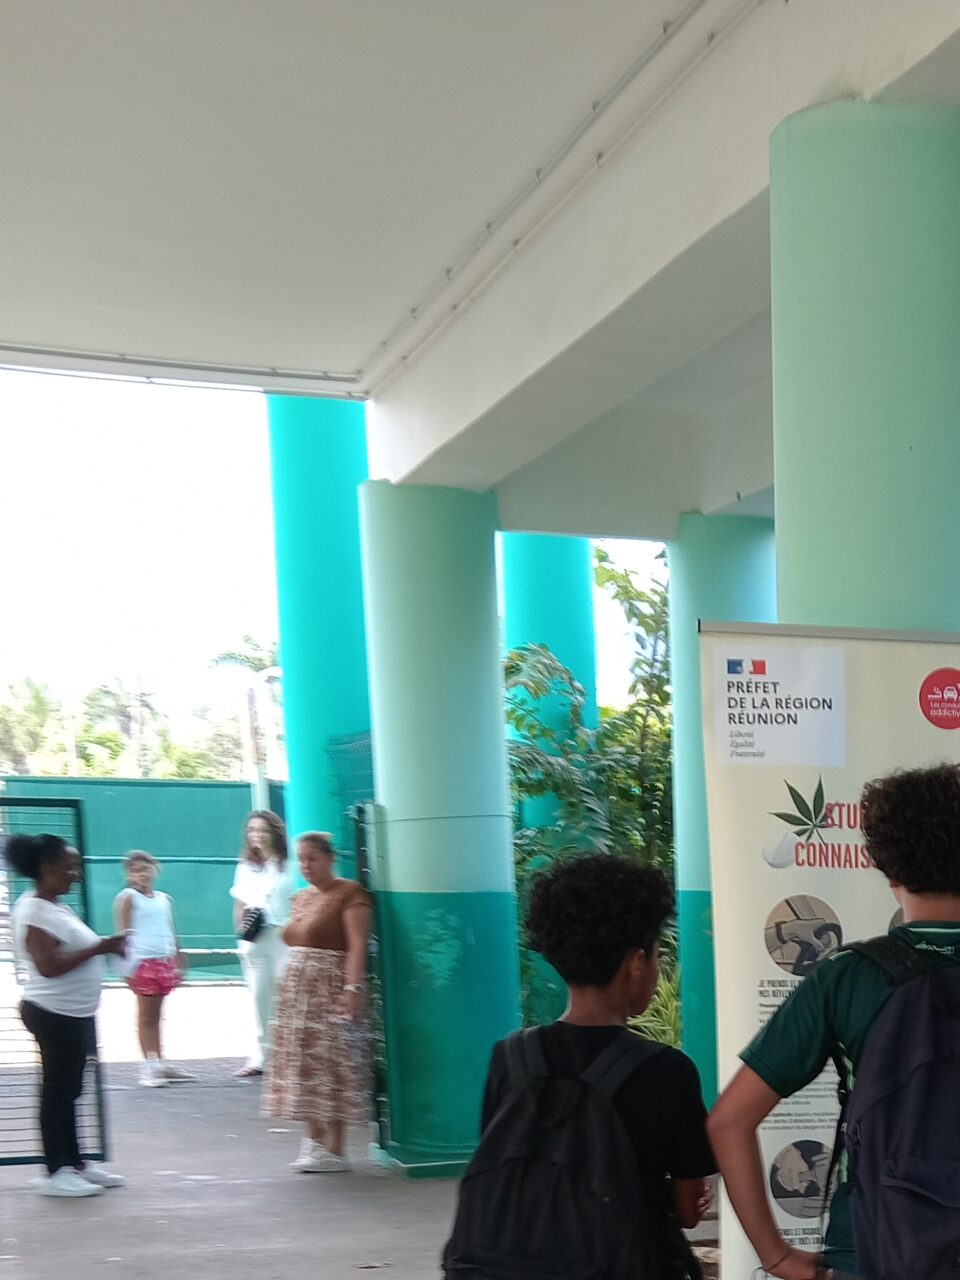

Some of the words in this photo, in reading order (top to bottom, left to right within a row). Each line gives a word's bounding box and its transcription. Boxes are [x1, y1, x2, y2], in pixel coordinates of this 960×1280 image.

[727, 678, 779, 694] PRÉFET
[727, 697, 746, 709] DE
[752, 697, 770, 710] LA
[775, 694, 833, 711] RÉGION
[728, 709, 799, 725] RÉUNION
[825, 802, 865, 829] STU
[795, 842, 877, 869] CONNAIS
